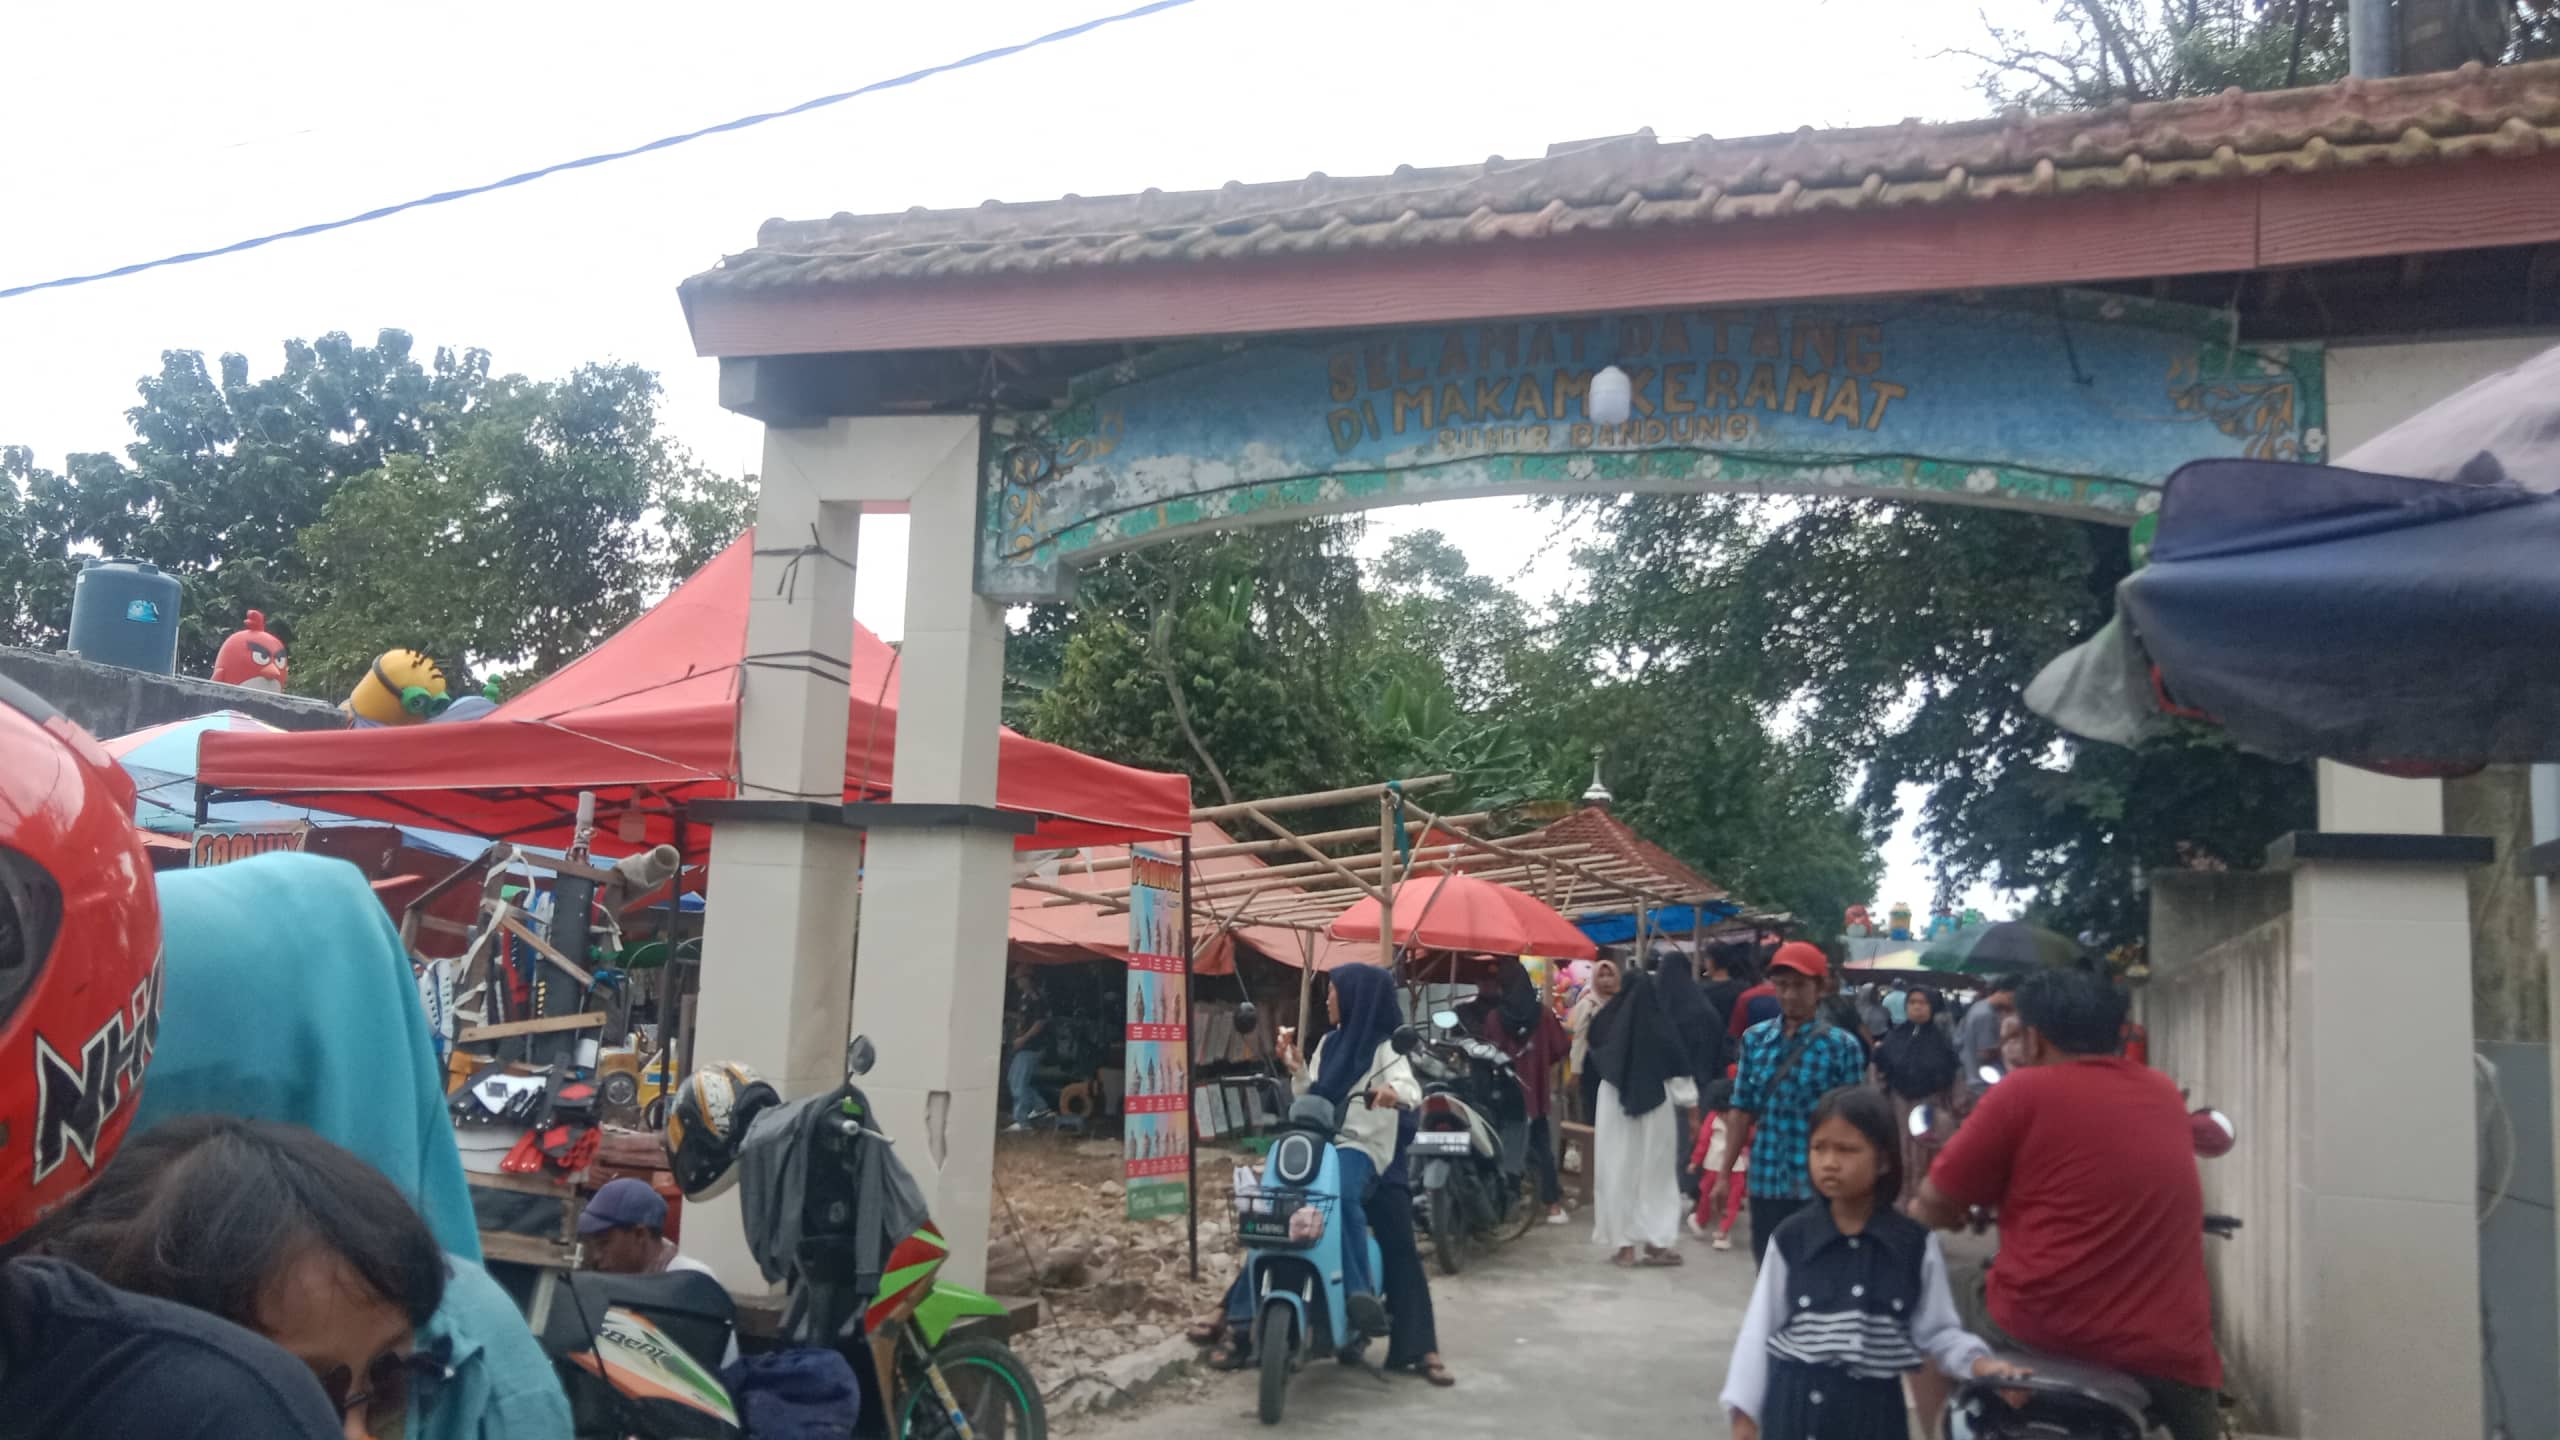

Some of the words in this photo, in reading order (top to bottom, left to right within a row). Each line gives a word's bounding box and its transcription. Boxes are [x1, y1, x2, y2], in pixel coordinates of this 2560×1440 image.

[1328, 318, 1595, 403] SELAMAT
[1617, 306, 1884, 376] DATANG
[1326, 399, 1382, 455] DI
[1391, 366, 1593, 434] MAKAM
[1630, 358, 1906, 432] KERAMAT
